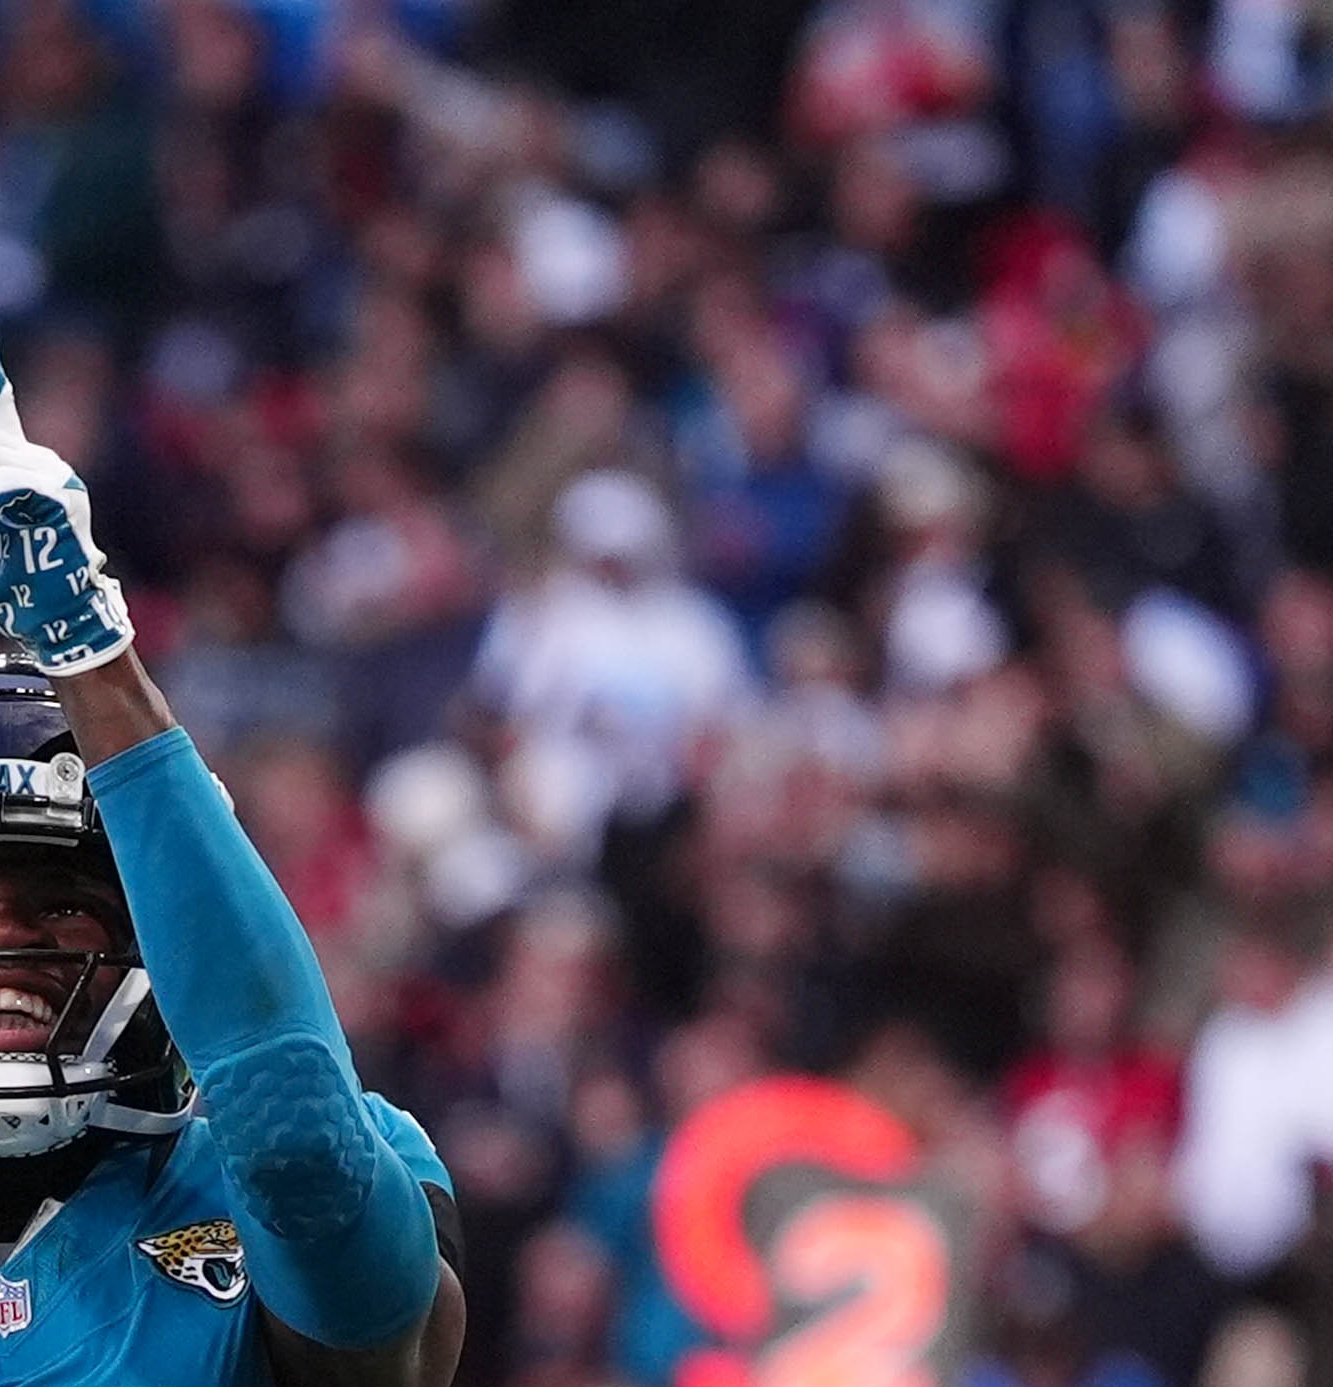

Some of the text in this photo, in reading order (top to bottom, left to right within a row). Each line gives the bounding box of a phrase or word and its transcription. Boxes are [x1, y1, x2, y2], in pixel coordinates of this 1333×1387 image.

[19, 526, 64, 574] 12
[65, 566, 90, 596] 12
[10, 583, 35, 608] 12
[42, 619, 73, 643] 12
